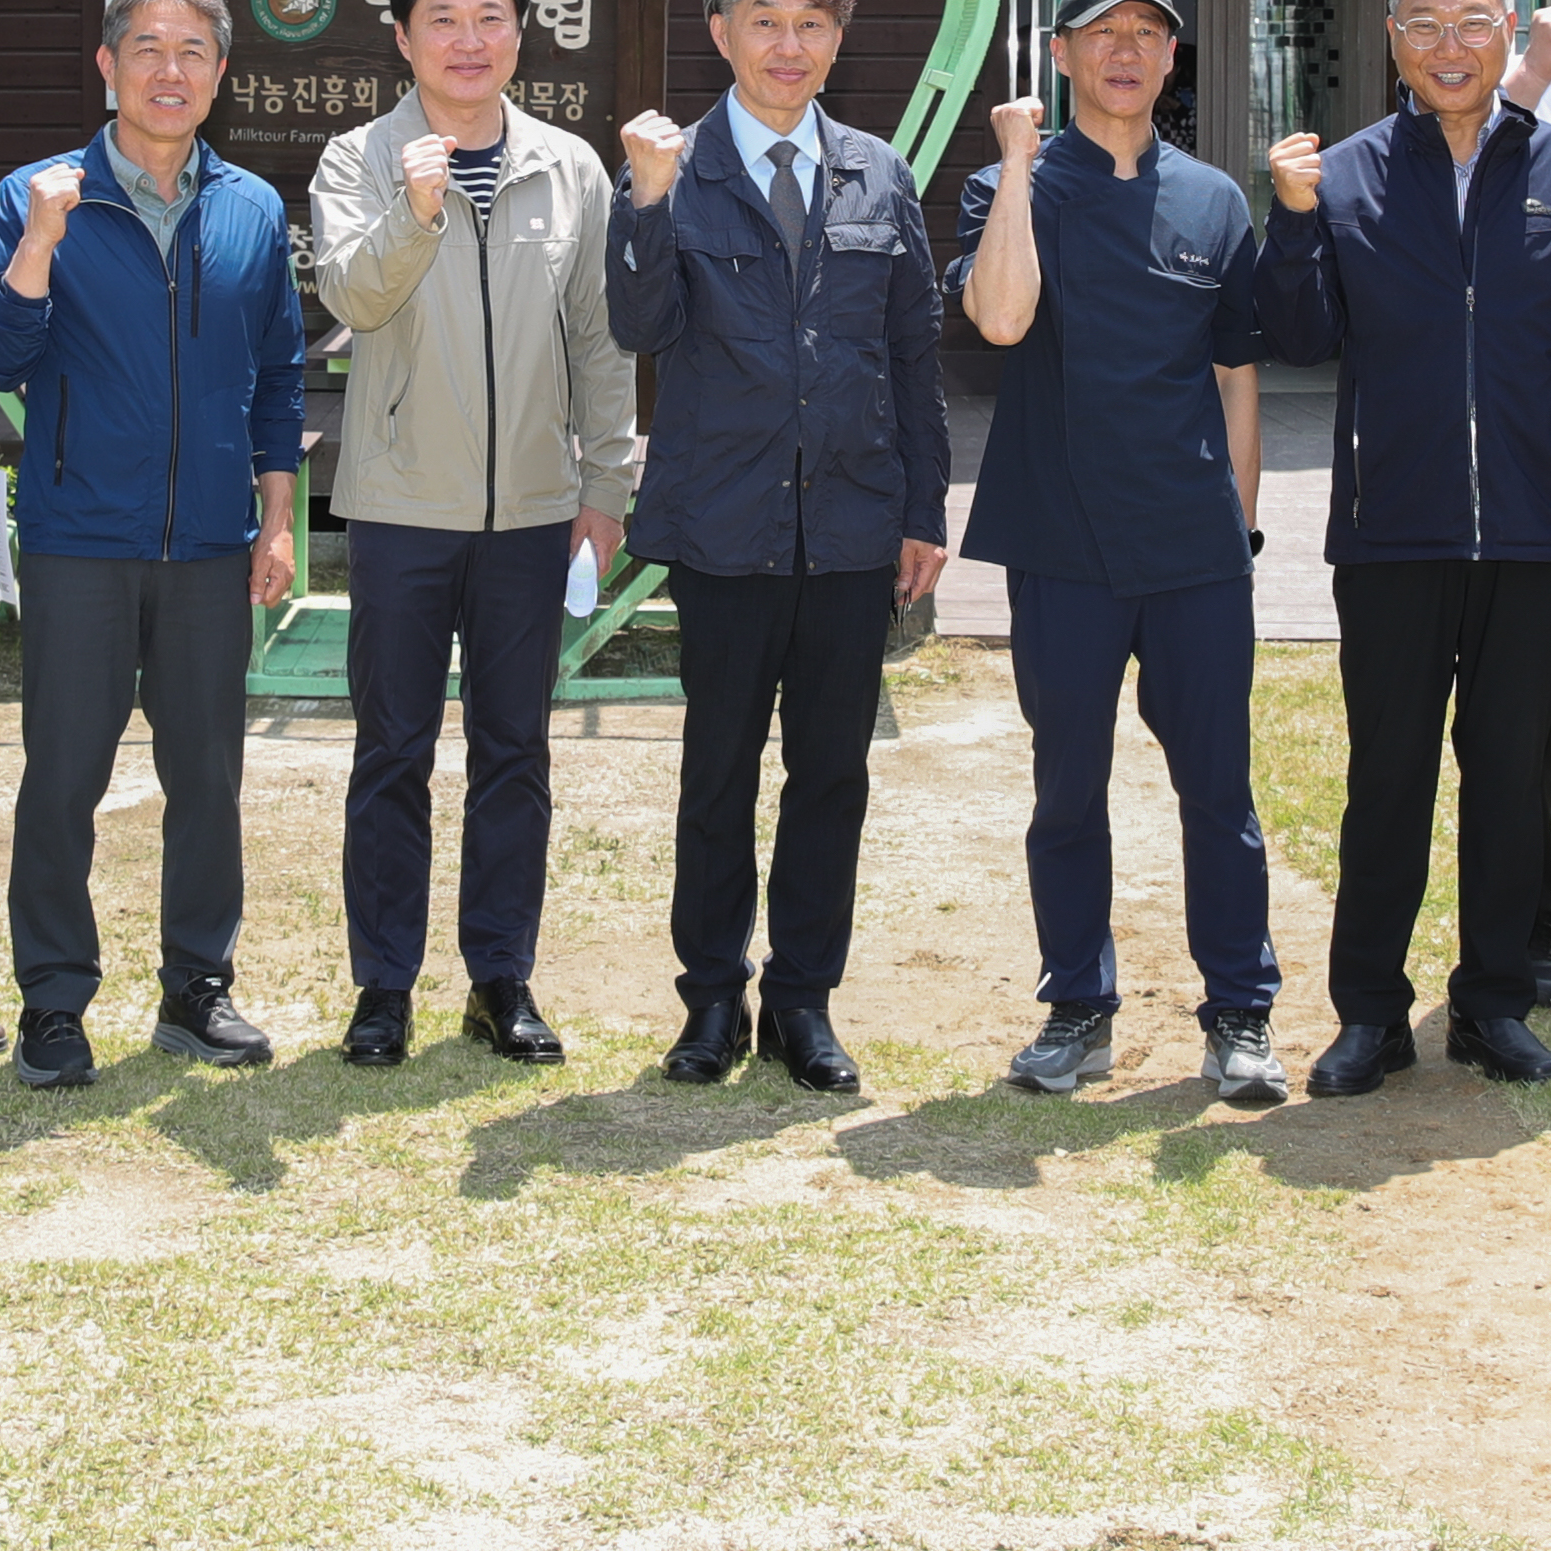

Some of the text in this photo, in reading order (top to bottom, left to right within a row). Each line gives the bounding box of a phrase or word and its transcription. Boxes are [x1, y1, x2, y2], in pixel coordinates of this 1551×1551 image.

[230, 73, 379, 116] 낙농진흥회
[504, 80, 589, 122] 험목장
[229, 127, 287, 143] Milktour
[289, 129, 326, 144] Farm
